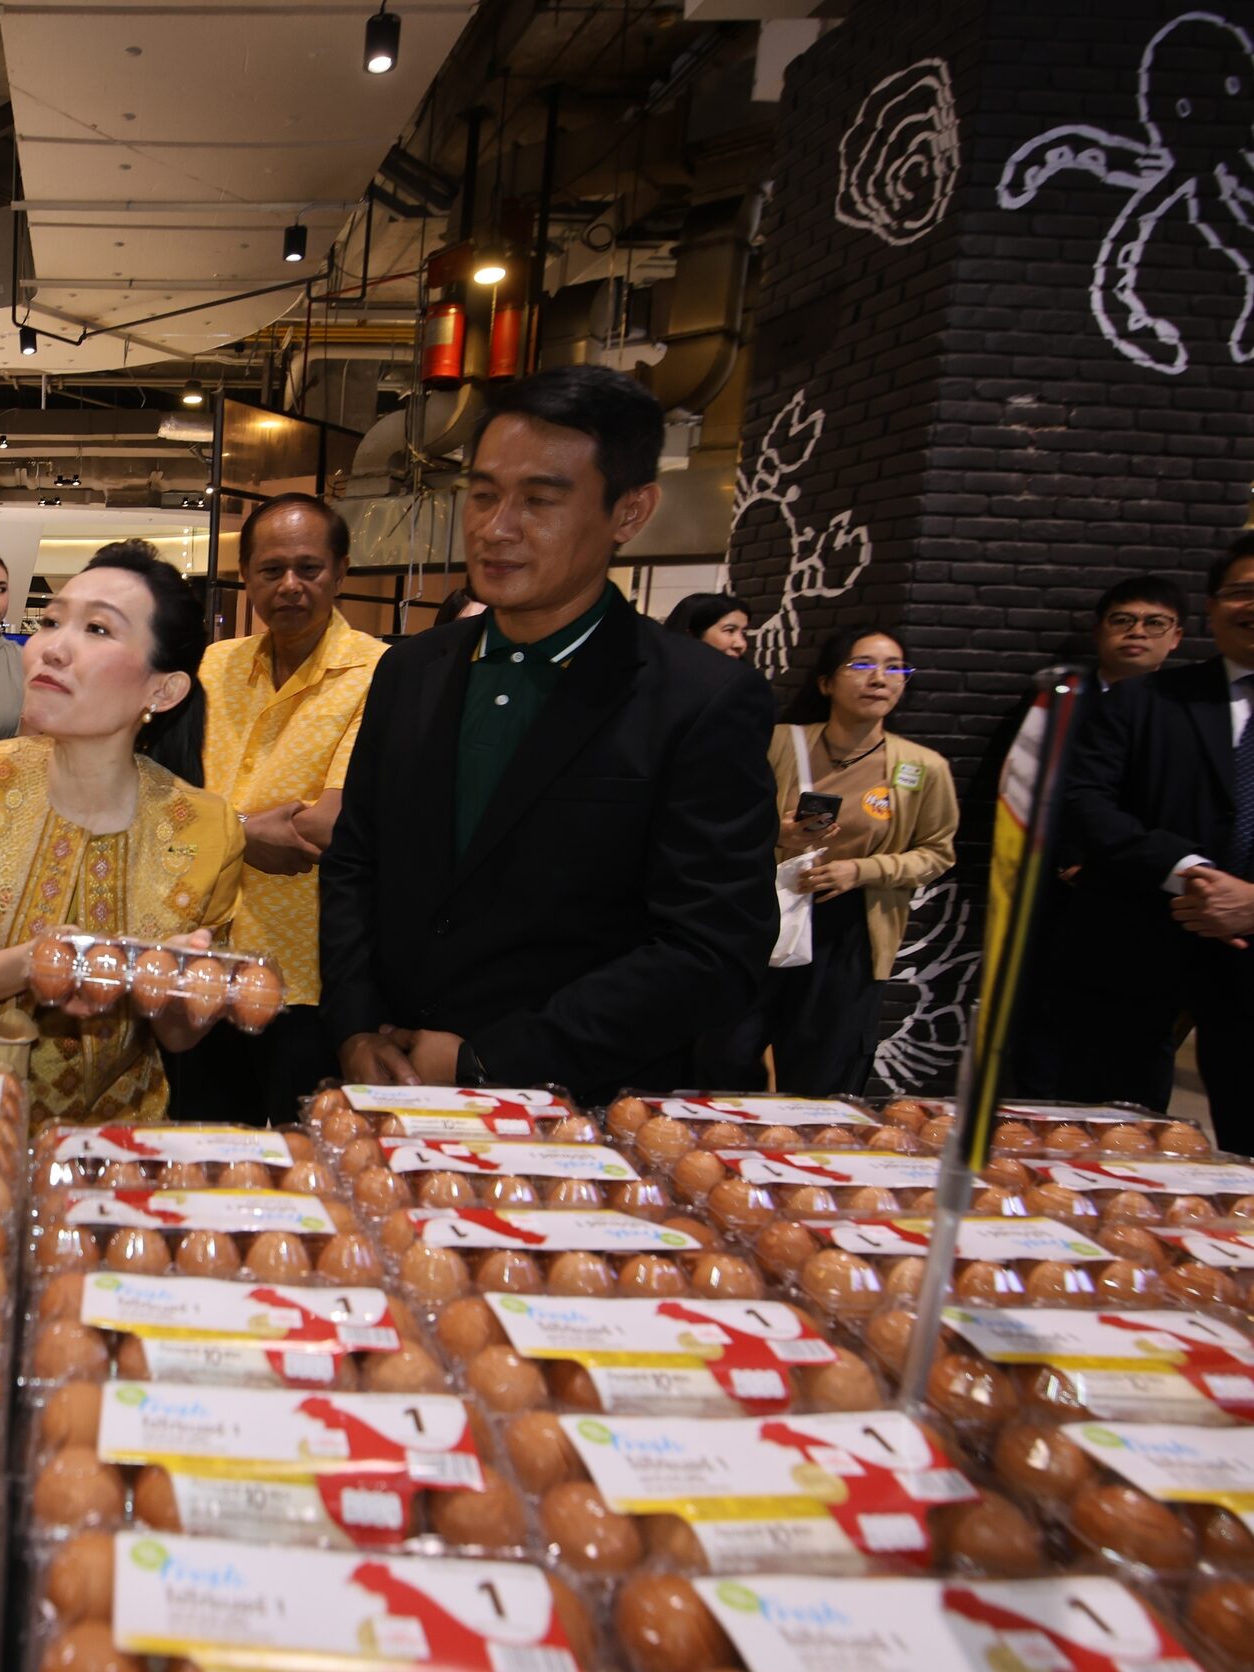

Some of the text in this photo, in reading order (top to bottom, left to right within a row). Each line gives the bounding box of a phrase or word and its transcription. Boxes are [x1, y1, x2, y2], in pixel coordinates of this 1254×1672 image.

[403, 1407, 426, 1434] 1
[862, 1425, 897, 1456] 1
[476, 1579, 507, 1619] 1
[1067, 1596, 1118, 1639] 1
